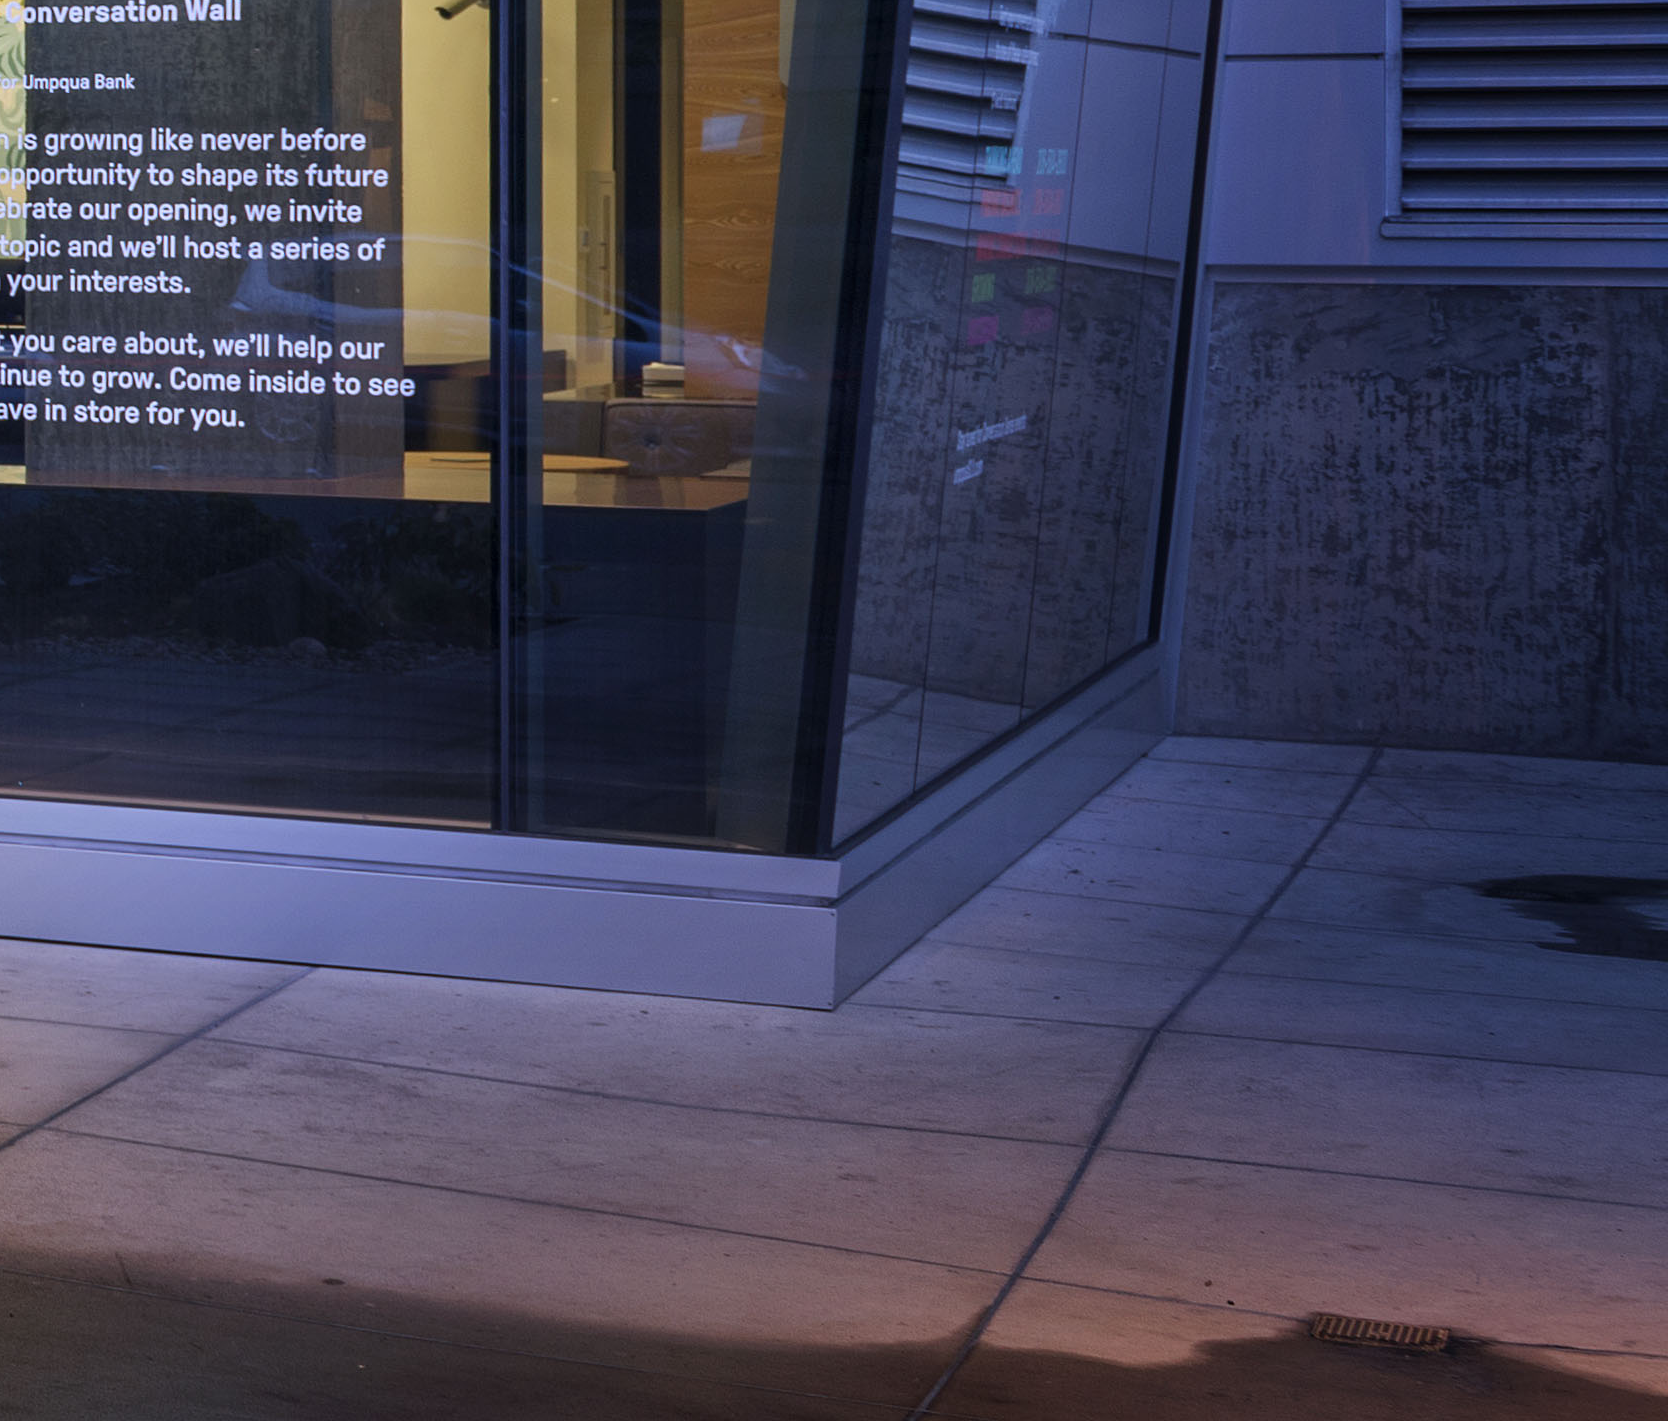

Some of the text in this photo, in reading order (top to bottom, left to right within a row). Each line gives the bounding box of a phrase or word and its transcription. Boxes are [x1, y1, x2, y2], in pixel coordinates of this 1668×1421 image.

[5, 0, 177, 23] Conversation
[18, 128, 37, 150] is
[151, 127, 193, 150] like
[200, 133, 274, 151] never
[281, 127, 366, 151] before
[147, 163, 174, 185] to
[181, 162, 258, 192] shape
[266, 163, 299, 187] its
[305, 163, 389, 187] future
[79, 202, 121, 220] our
[128, 197, 237, 227] opening,
[245, 203, 282, 222] we
[289, 198, 363, 223] invite
[68, 235, 113, 258] and
[184, 235, 241, 259] host
[248, 241, 263, 259] a
[270, 237, 350, 261] series
[357, 238, 386, 261] of
[8, 273, 63, 297] your
[70, 269, 192, 294] interests.
[11, 334, 55, 357] you
[62, 335, 117, 353] care
[124, 331, 205, 359] about,
[278, 334, 333, 364] help
[340, 341, 385, 359] our
[59, 364, 85, 387] to
[92, 370, 162, 393] grow.
[170, 367, 241, 391] Come
[249, 369, 326, 395] inside
[333, 371, 361, 396] to
[368, 378, 416, 397] see
[45, 399, 66, 421] in
[74, 400, 140, 424] store
[147, 402, 184, 425] for
[190, 408, 245, 432] you.
